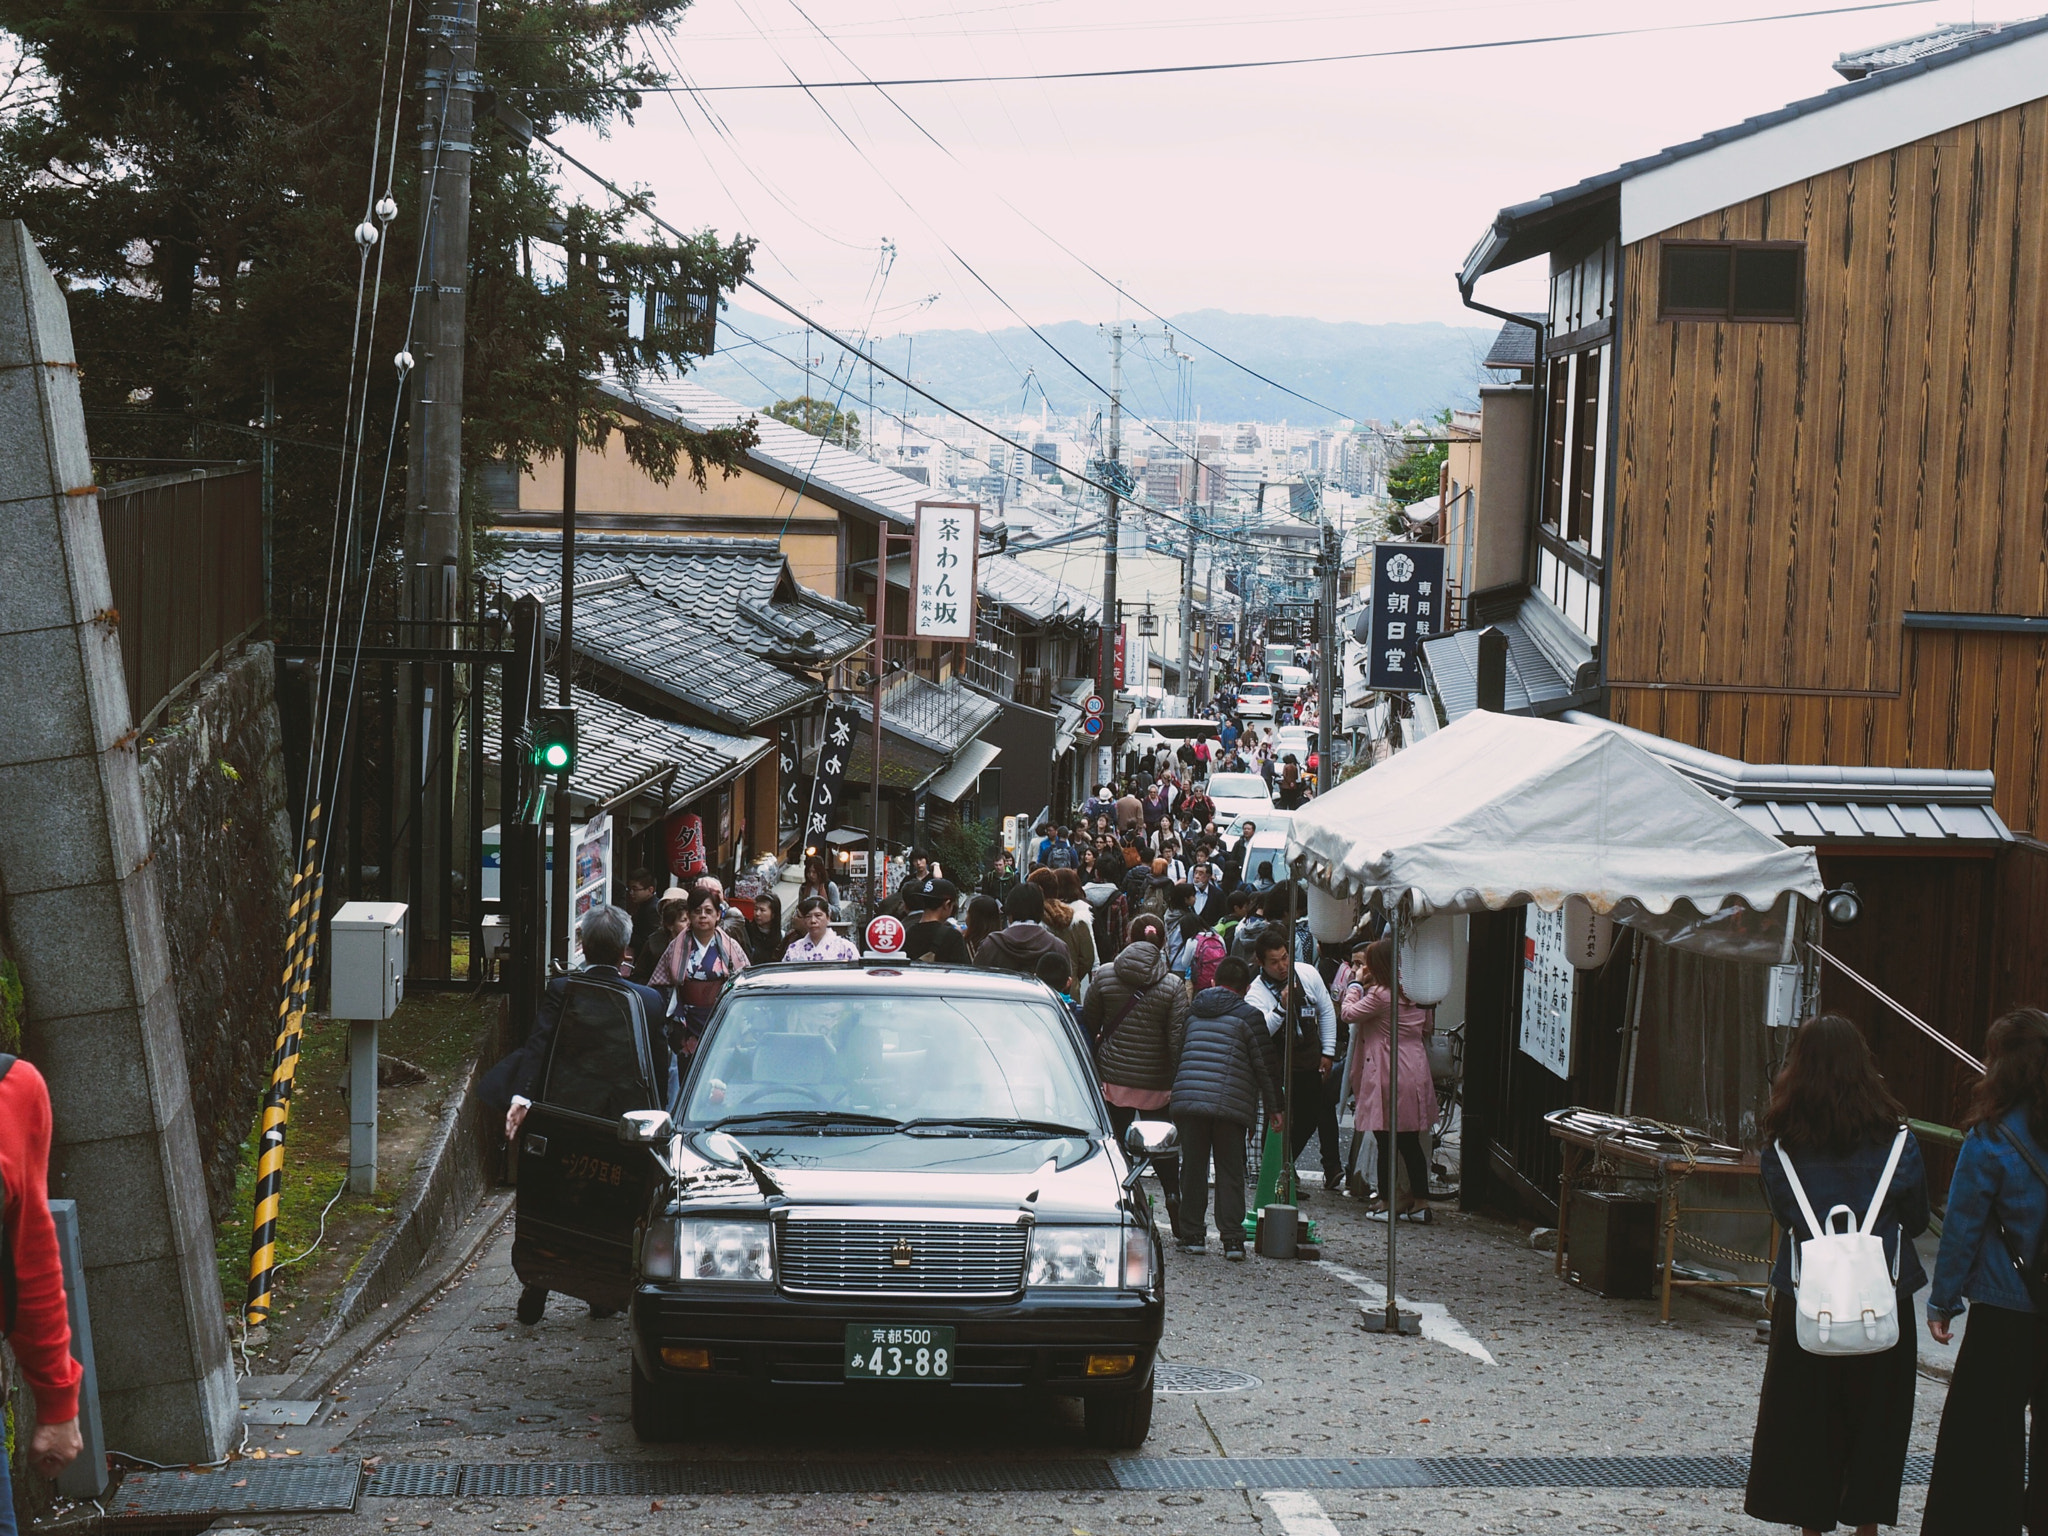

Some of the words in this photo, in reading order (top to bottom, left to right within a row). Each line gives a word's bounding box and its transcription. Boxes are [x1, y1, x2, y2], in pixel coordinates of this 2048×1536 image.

[934, 518, 960, 625] 茶わん坂
[920, 583, 932, 627] 繁栄会
[1385, 592, 1410, 672] 朝日堂
[1089, 701, 1100, 710] 30
[851, 1353, 864, 1368] あ
[868, 1346, 948, 1377] 43-88
